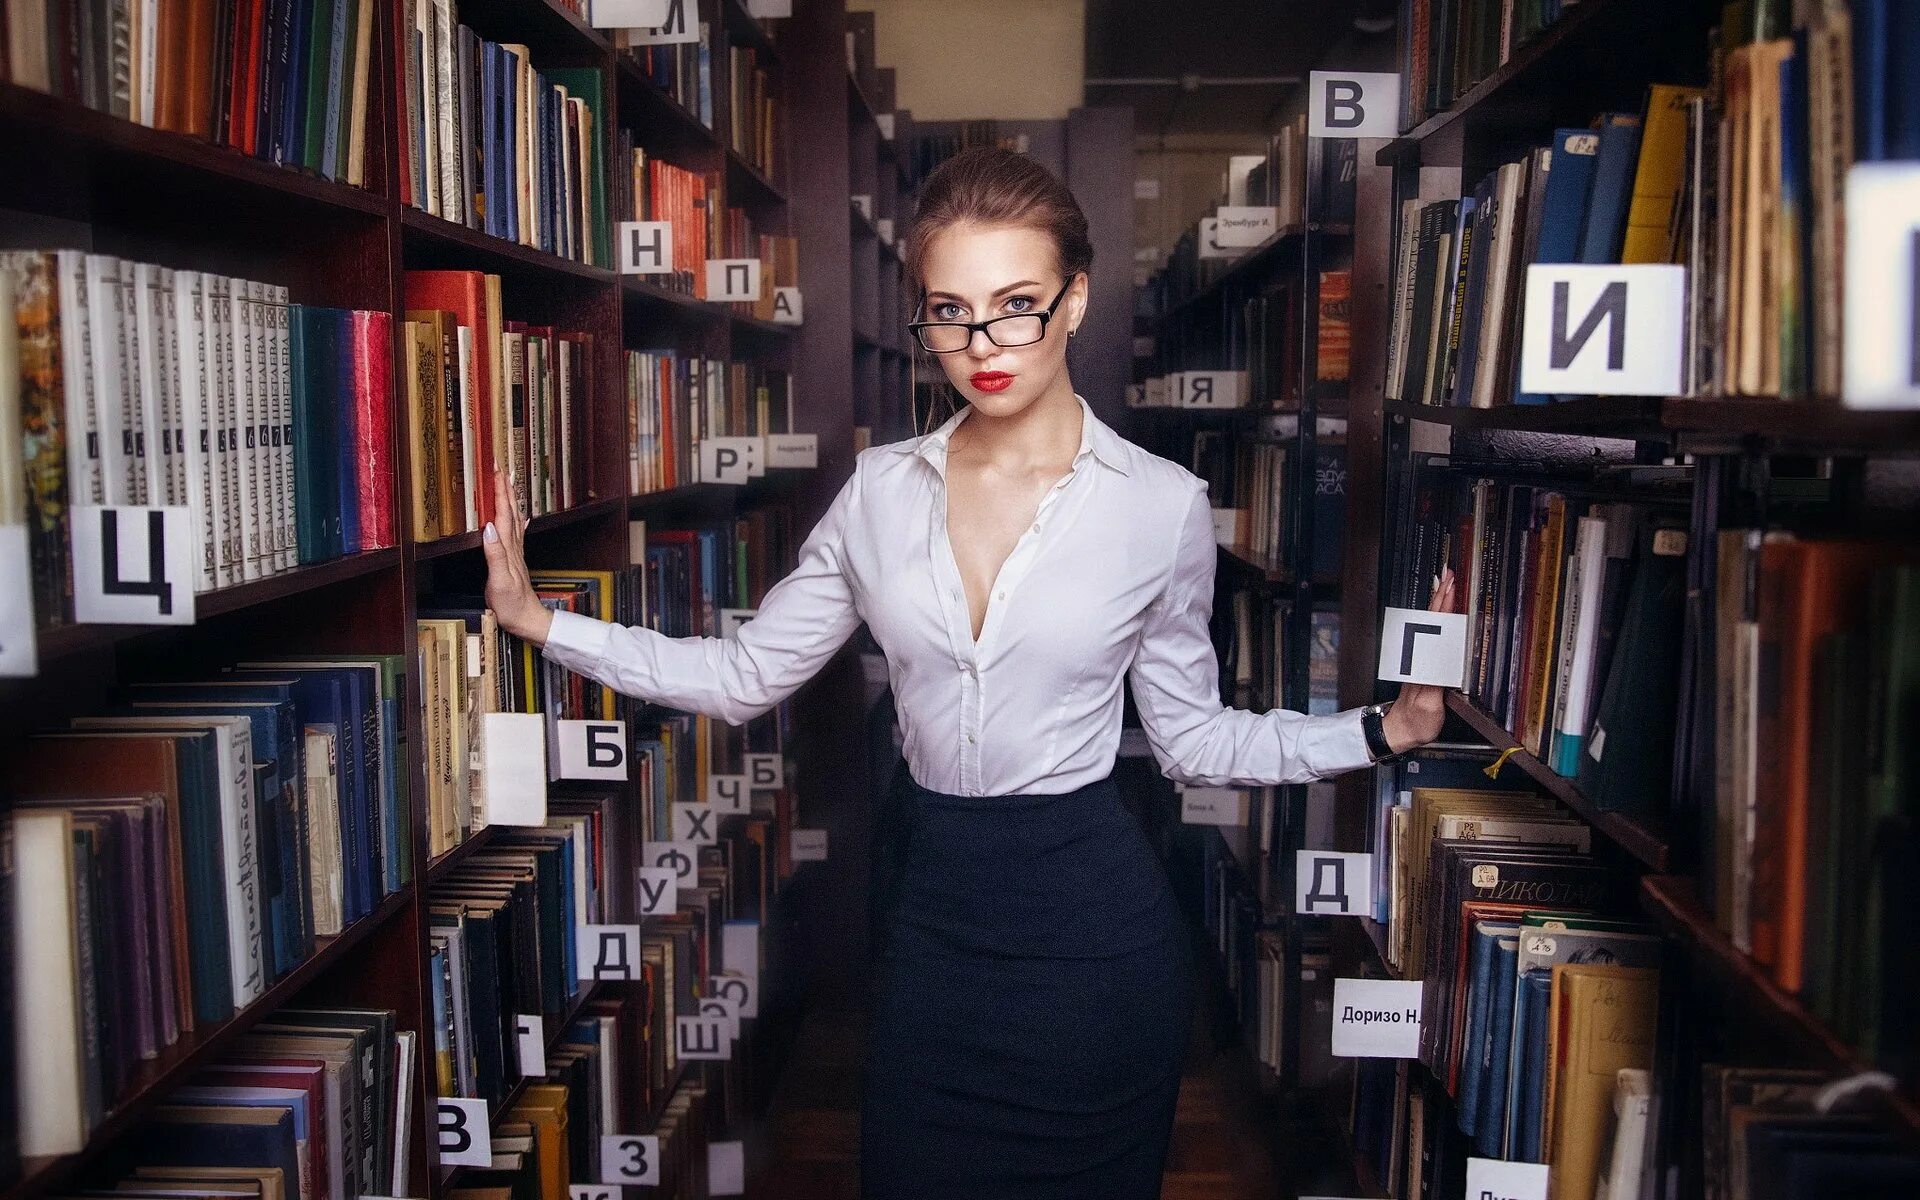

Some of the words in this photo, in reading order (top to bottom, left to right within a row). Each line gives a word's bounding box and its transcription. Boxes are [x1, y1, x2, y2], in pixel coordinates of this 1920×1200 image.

[1324, 80, 1364, 128] В
[632, 229, 662, 267] Н
[726, 264, 749, 295] П
[774, 292, 792, 316] А
[1549, 282, 1628, 372] И
[1190, 377, 1213, 404] Я
[248, 428, 254, 447] 6
[261, 427, 268, 445] 6
[273, 430, 280, 446] 7
[716, 448, 738, 478] Р
[336, 517, 340, 534] 2
[101, 510, 172, 615] Ц
[1400, 622, 1442, 676] Г
[586, 725, 623, 767] Б
[752, 759, 776, 784] Б
[717, 781, 740, 808] Ч
[685, 810, 711, 840] Х
[656, 848, 692, 878] Ф
[640, 878, 667, 912] У
[1305, 858, 1348, 912] Д
[594, 932, 630, 980] Д
[1342, 1006, 1400, 1025] Доризо
[1406, 1009, 1422, 1024] Н.
[681, 1024, 719, 1052] Ш
[438, 1105, 472, 1153] В
[619, 1140, 648, 1176] З
